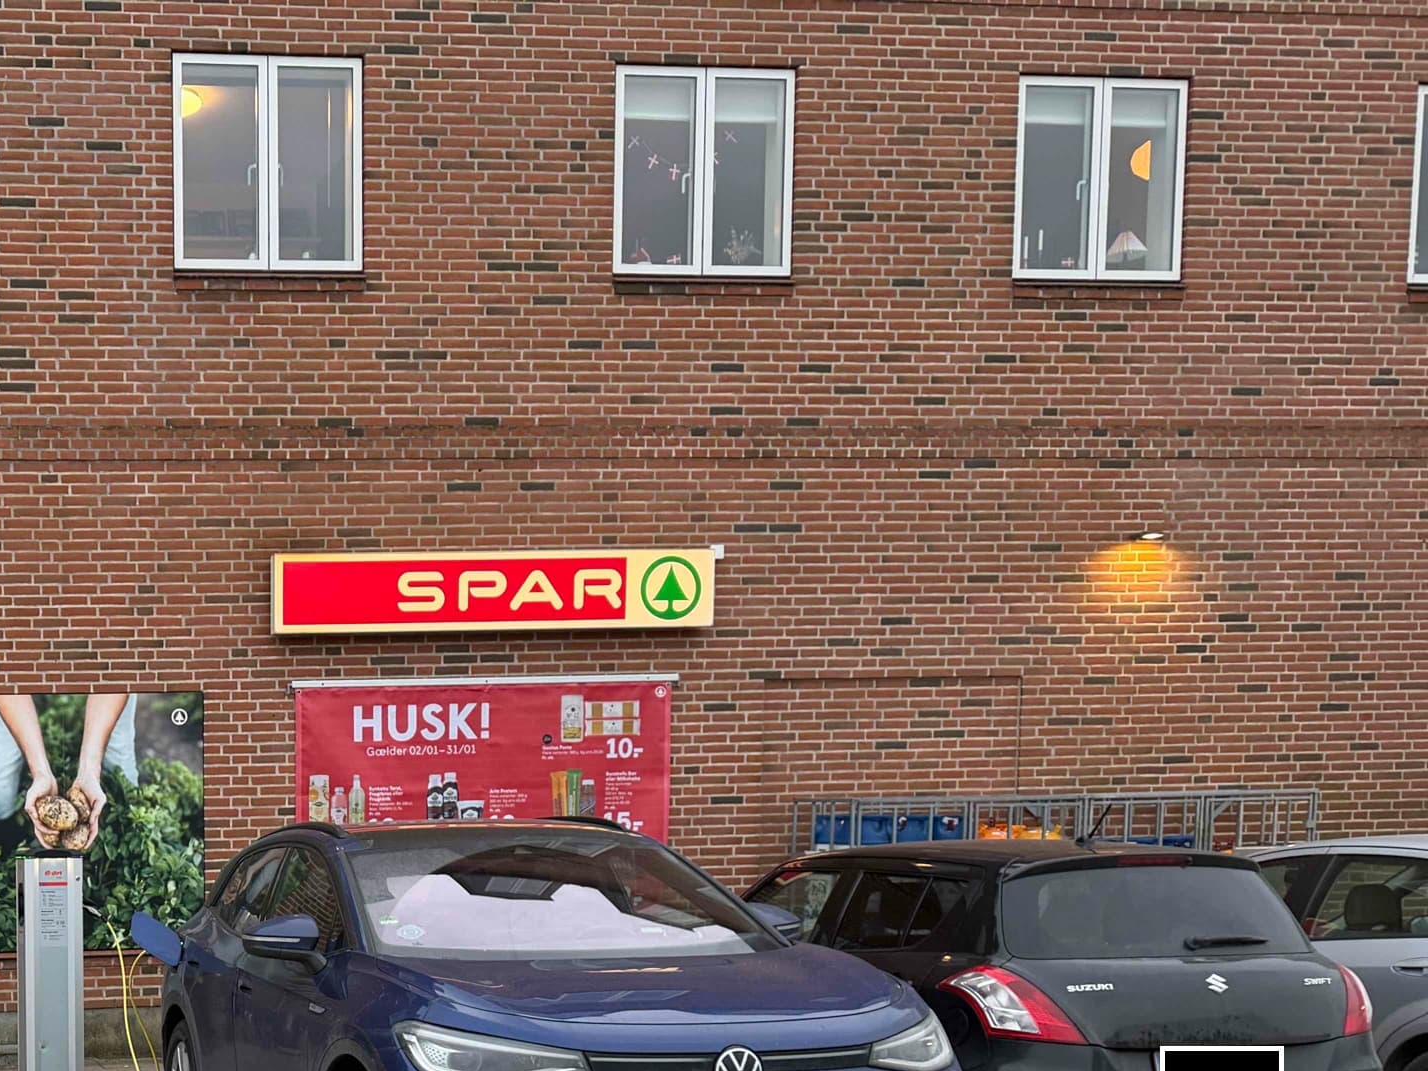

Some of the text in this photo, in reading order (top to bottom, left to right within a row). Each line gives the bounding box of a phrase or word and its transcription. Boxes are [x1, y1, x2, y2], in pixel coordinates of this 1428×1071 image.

[397, 568, 623, 612] SPAR
[353, 702, 490, 742] HUSK!
[366, 746, 407, 757] Gælder
[1066, 983, 1114, 993] SUZUKI
